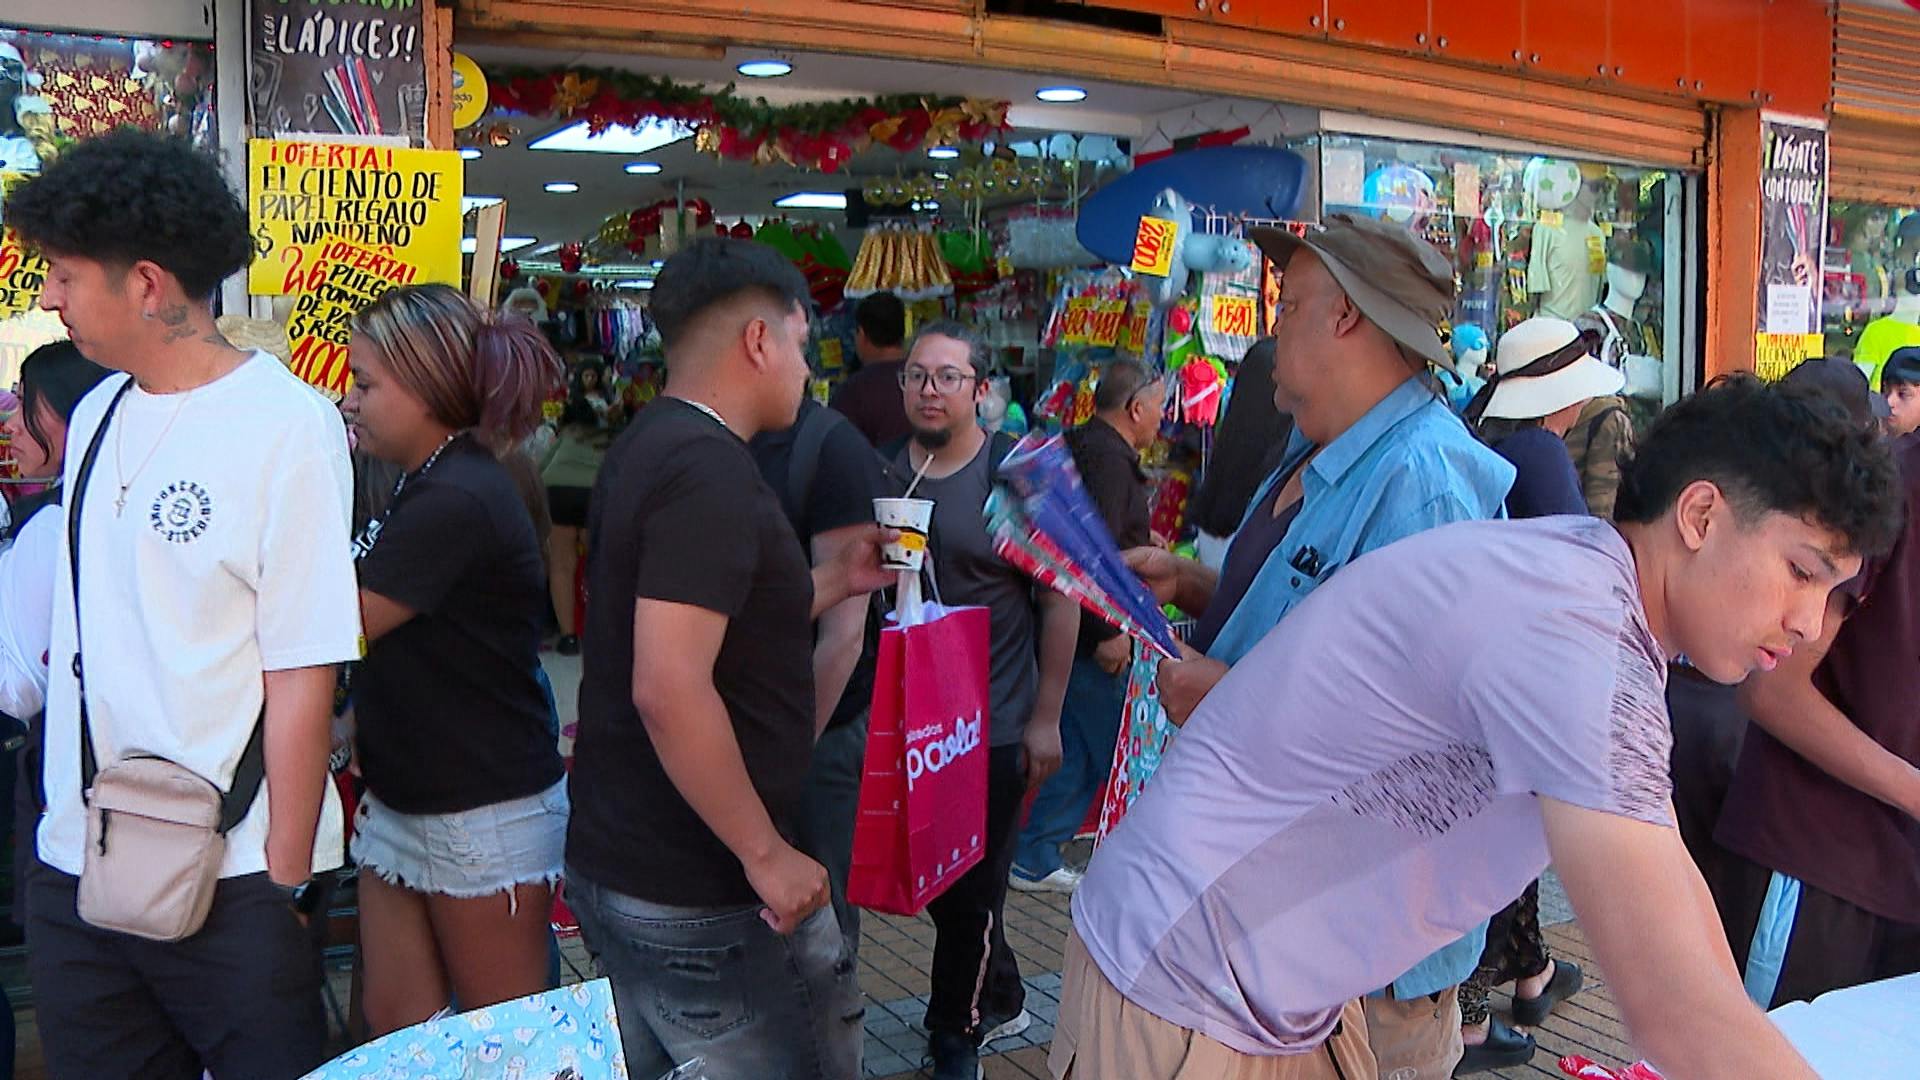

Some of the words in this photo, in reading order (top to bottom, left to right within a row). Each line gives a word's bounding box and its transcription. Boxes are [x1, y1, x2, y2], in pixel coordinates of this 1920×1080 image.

[278, 10, 415, 62] LÁPICES!
[262, 166, 288, 190] EL
[300, 169, 401, 200] CIENTO
[411, 172, 443, 202] DE
[260, 194, 326, 221] PAPEL
[335, 199, 427, 226] REGALO
[256, 222, 273, 259] $
[1134, 219, 1166, 268] 2900
[296, 294, 323, 319] DE
[325, 306, 352, 326] PA
[315, 282, 371, 313] COMP
[308, 319, 349, 345] REG
[1215, 303, 1252, 337] 1590
[290, 336, 351, 396] 100
[906, 709, 982, 793] paola!
